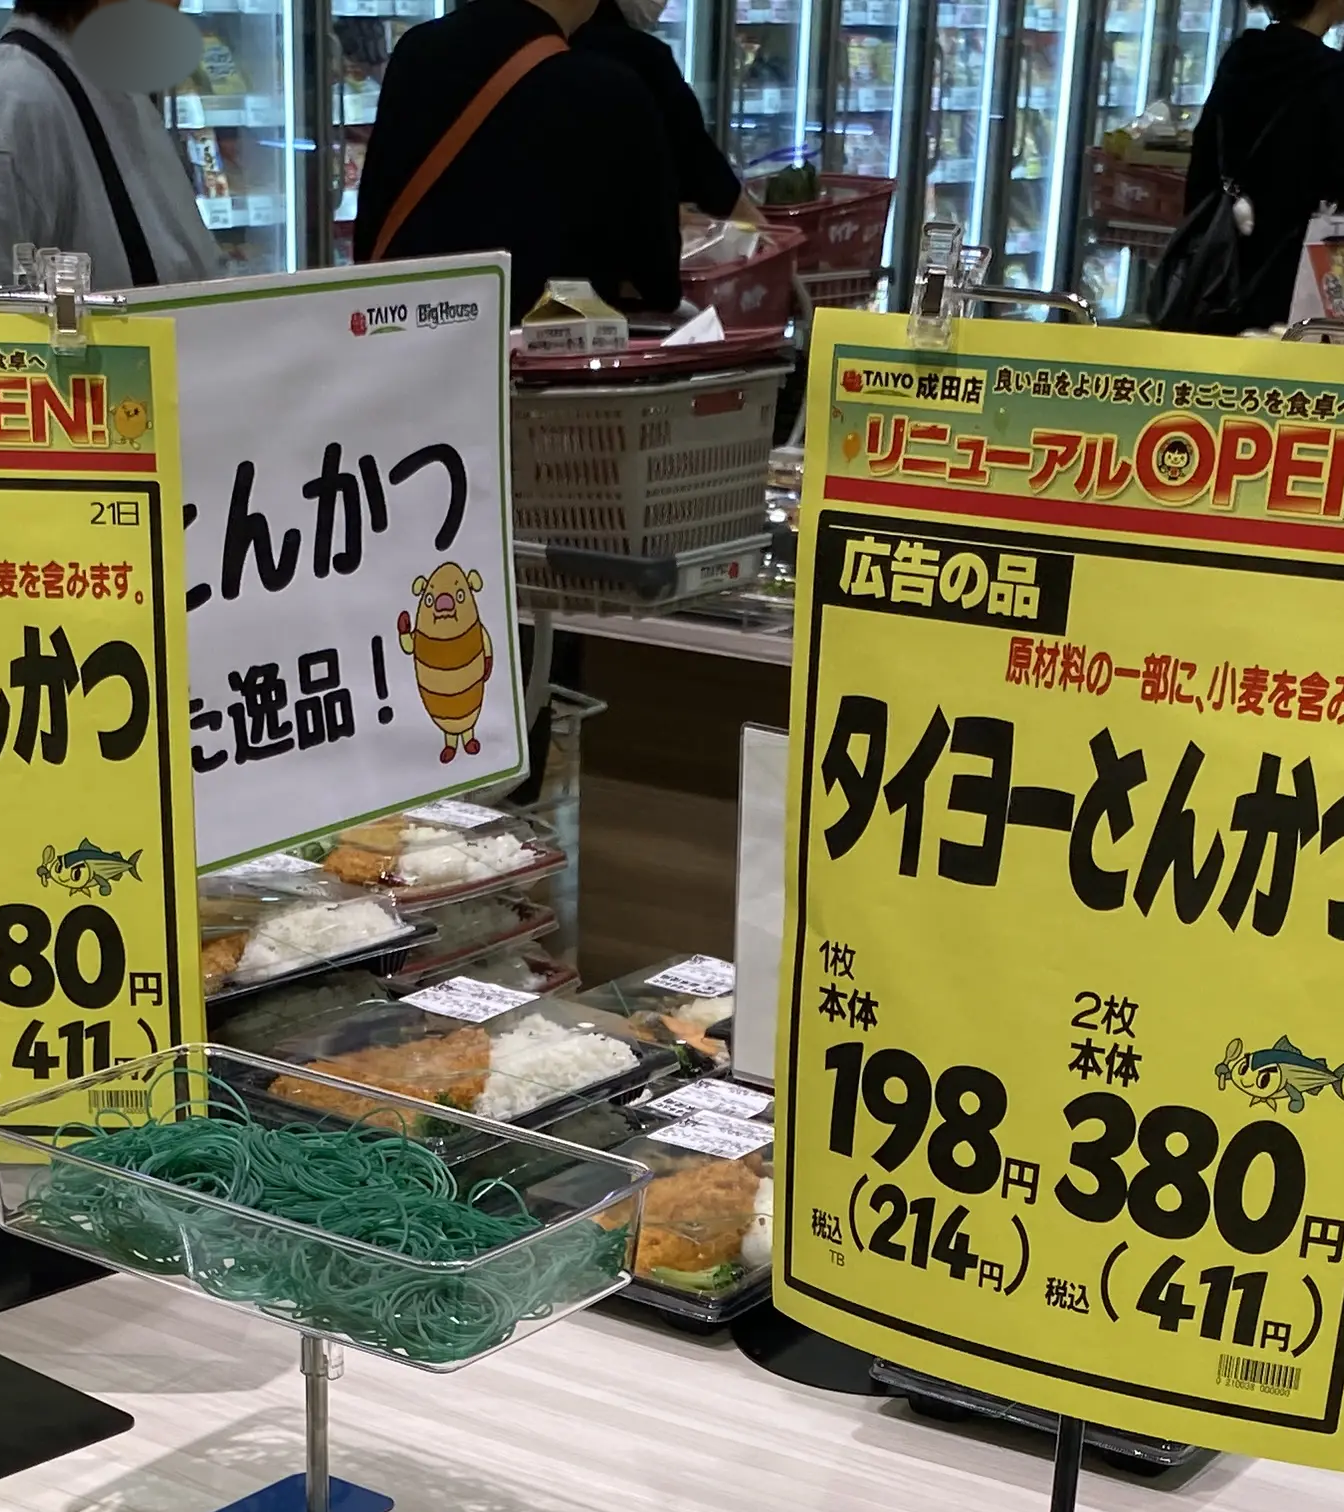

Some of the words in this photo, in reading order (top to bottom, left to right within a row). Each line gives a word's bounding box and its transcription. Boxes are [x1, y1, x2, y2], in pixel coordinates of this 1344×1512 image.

[367, 304, 408, 325] TAIYO
[862, 370, 914, 391] TAIYO
[915, 373, 984, 405] 成田店
[89, 501, 140, 527] 21日
[183, 441, 468, 613] んかつ
[838, 535, 1042, 620] 広告の品
[819, 940, 856, 981] 1枚
[818, 982, 879, 1032] 本体
[1070, 991, 1139, 1038] 2枚
[1068, 1038, 1143, 1088] 本体
